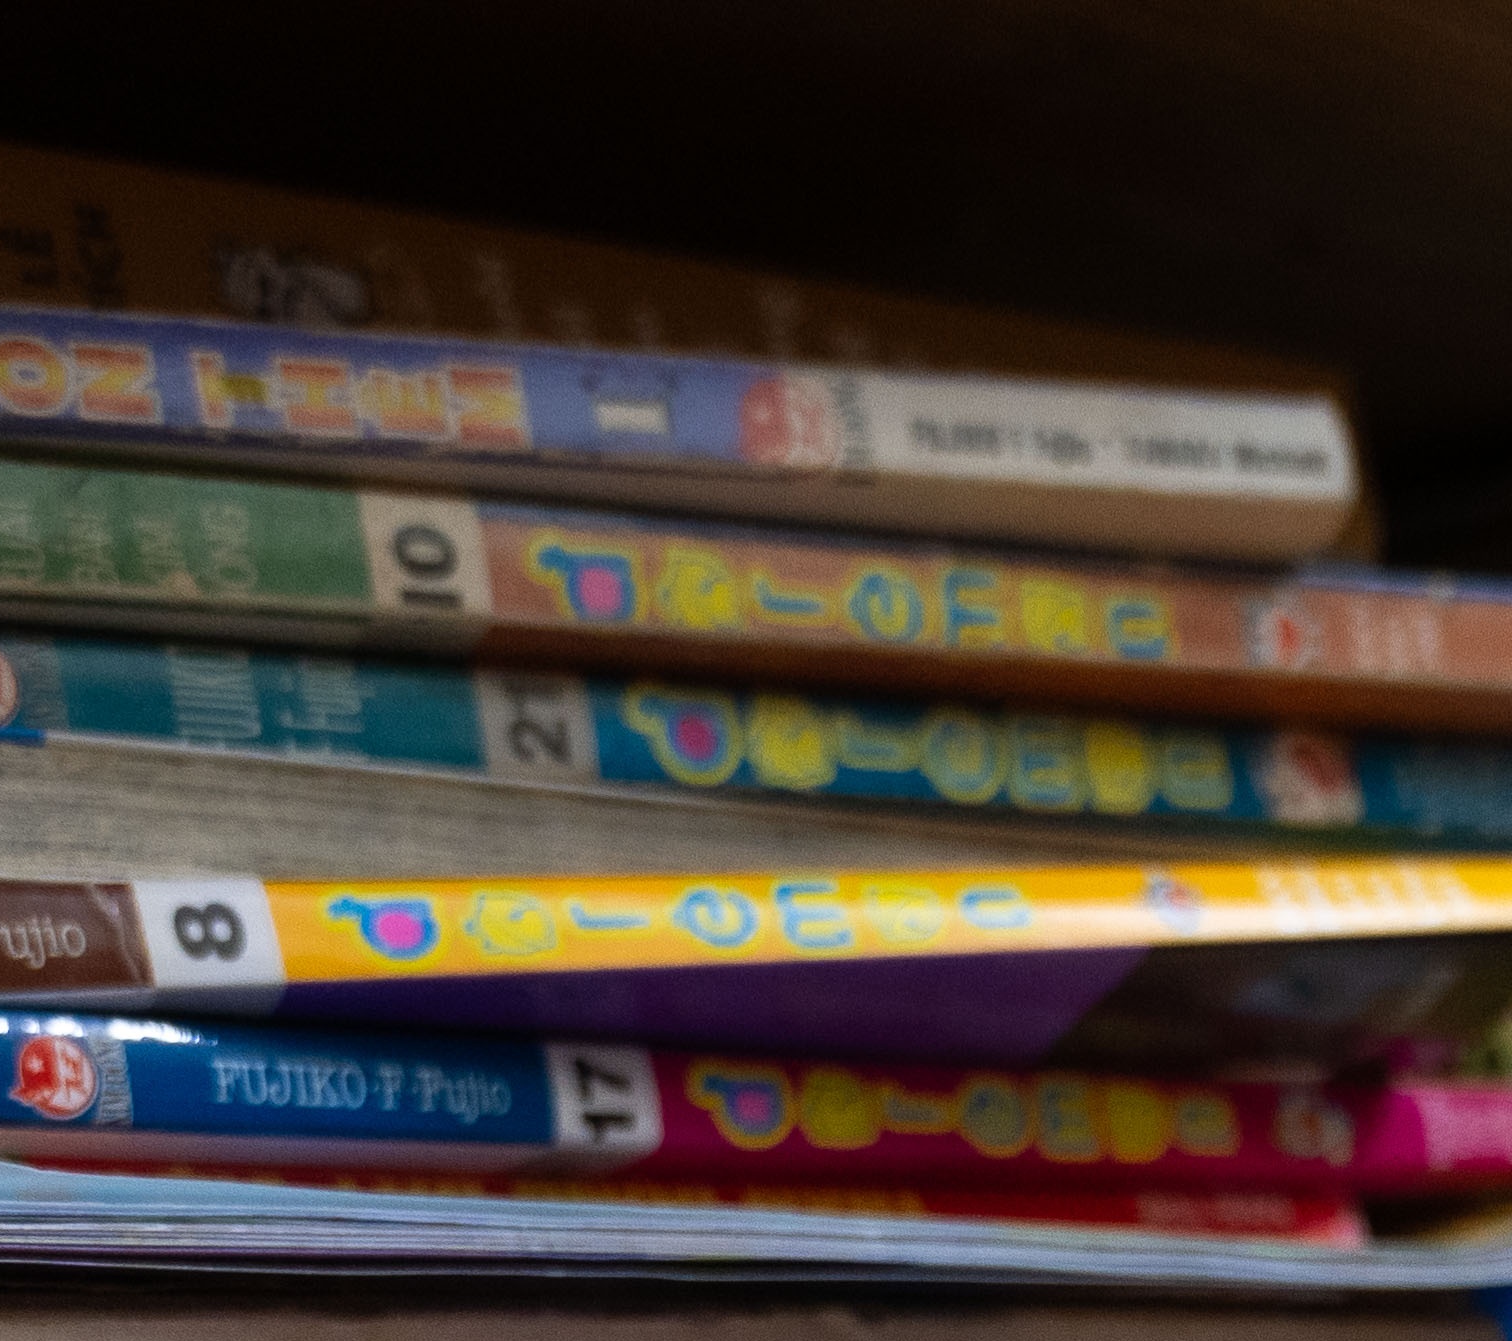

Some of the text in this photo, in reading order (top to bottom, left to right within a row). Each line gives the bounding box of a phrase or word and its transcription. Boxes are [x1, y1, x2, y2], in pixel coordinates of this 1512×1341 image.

[393, 523, 465, 610] 10
[173, 901, 248, 961] 8
[571, 1058, 637, 1140] 17
